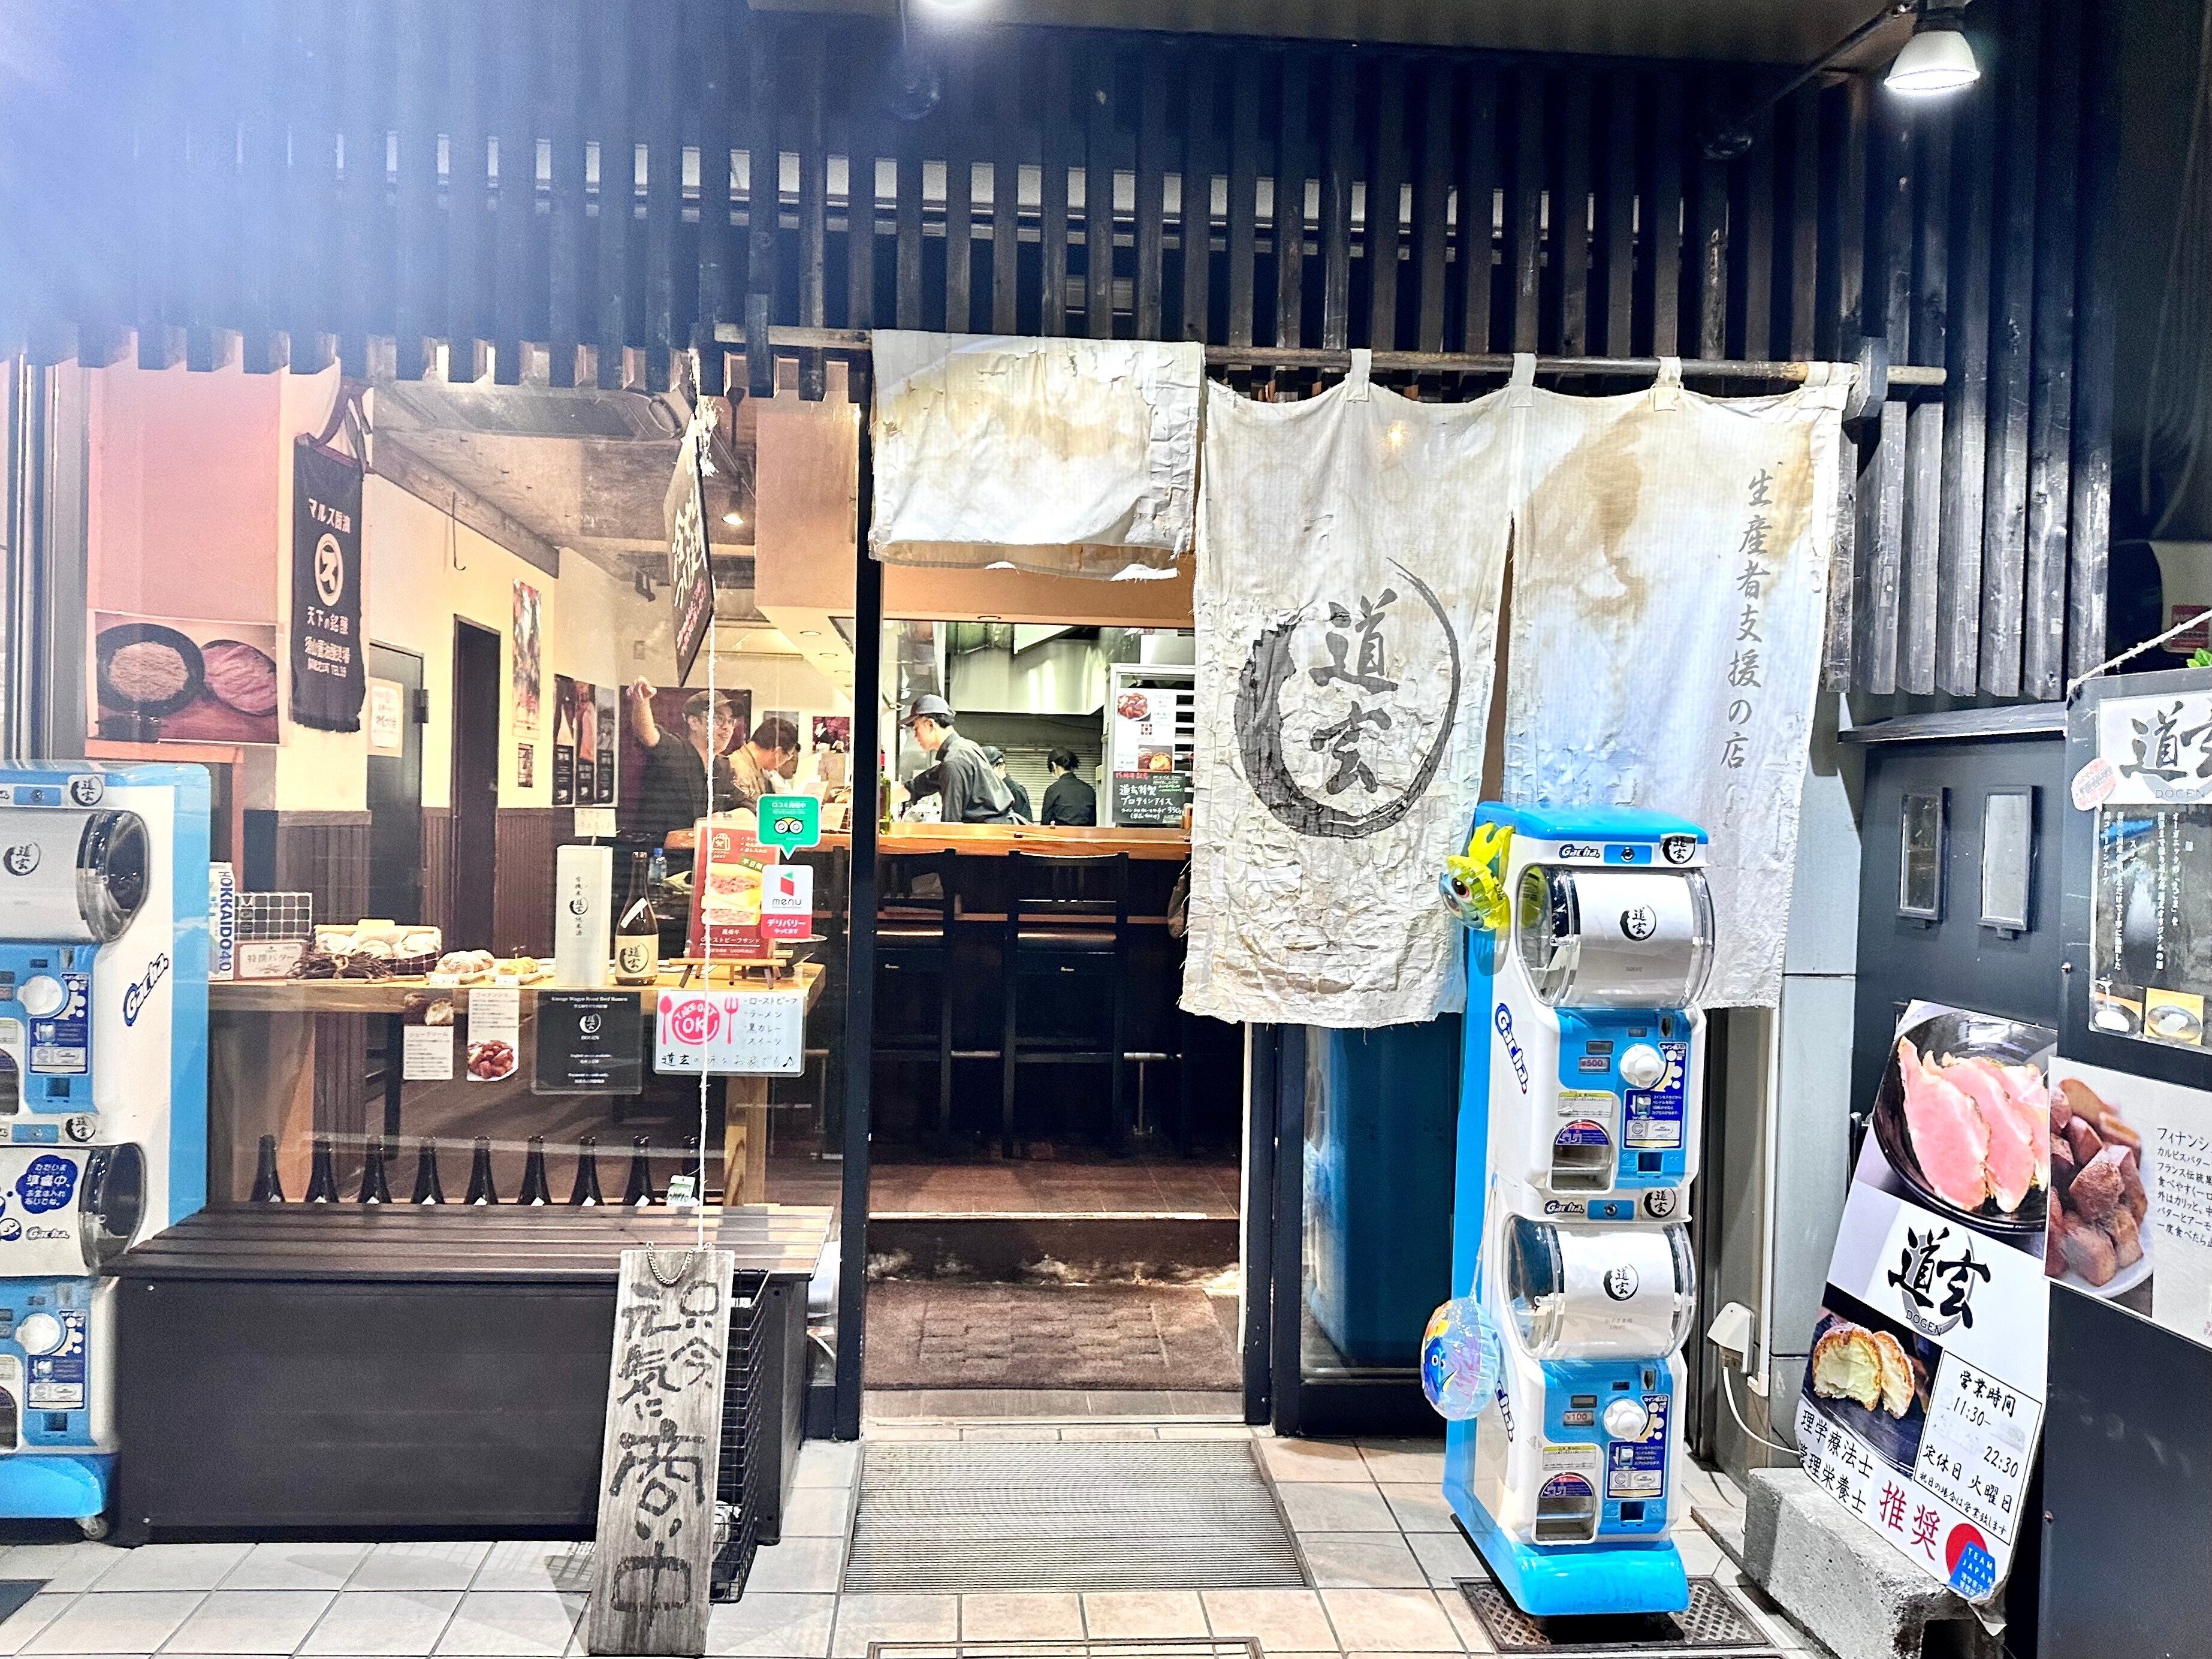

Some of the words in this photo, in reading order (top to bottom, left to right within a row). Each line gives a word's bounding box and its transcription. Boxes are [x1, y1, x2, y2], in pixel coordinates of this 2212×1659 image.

[1721, 469, 1773, 770] 生産者支援の店
[1309, 588, 1398, 795] 道玄
[1121, 795, 1174, 806] プロテインアイス
[2155, 789, 2205, 798] DOGEN
[16, 843, 32, 869] 道玄
[766, 918, 806, 927] デリバリー
[1632, 907, 1647, 934] 道玄
[627, 945, 641, 969] 道玄
[673, 1003, 697, 1020] TAKE
[682, 1018, 706, 1034] OK
[2157, 1127, 2212, 1153] フィナンシ
[1654, 1189, 1667, 1212] 道玄
[1615, 1265, 1629, 1294] 道玄
[1887, 1226, 1991, 1329] 道玄
[1906, 1310, 1943, 1337] DOGEN
[1960, 1370, 2016, 1417] 営業時間
[1801, 1409, 1873, 1479] 理学療法士
[1983, 1445, 2019, 1478] 22:30
[1922, 1444, 1962, 1482] 定休日
[1967, 1474, 2013, 1515] 火曜日
[1920, 1471, 2007, 1536] 祝日の場合は営業致します
[1879, 1479, 1941, 1561] 推奨
[1962, 1558, 1993, 1585] JAPAN
[1967, 1547, 1993, 1570] TEAM
